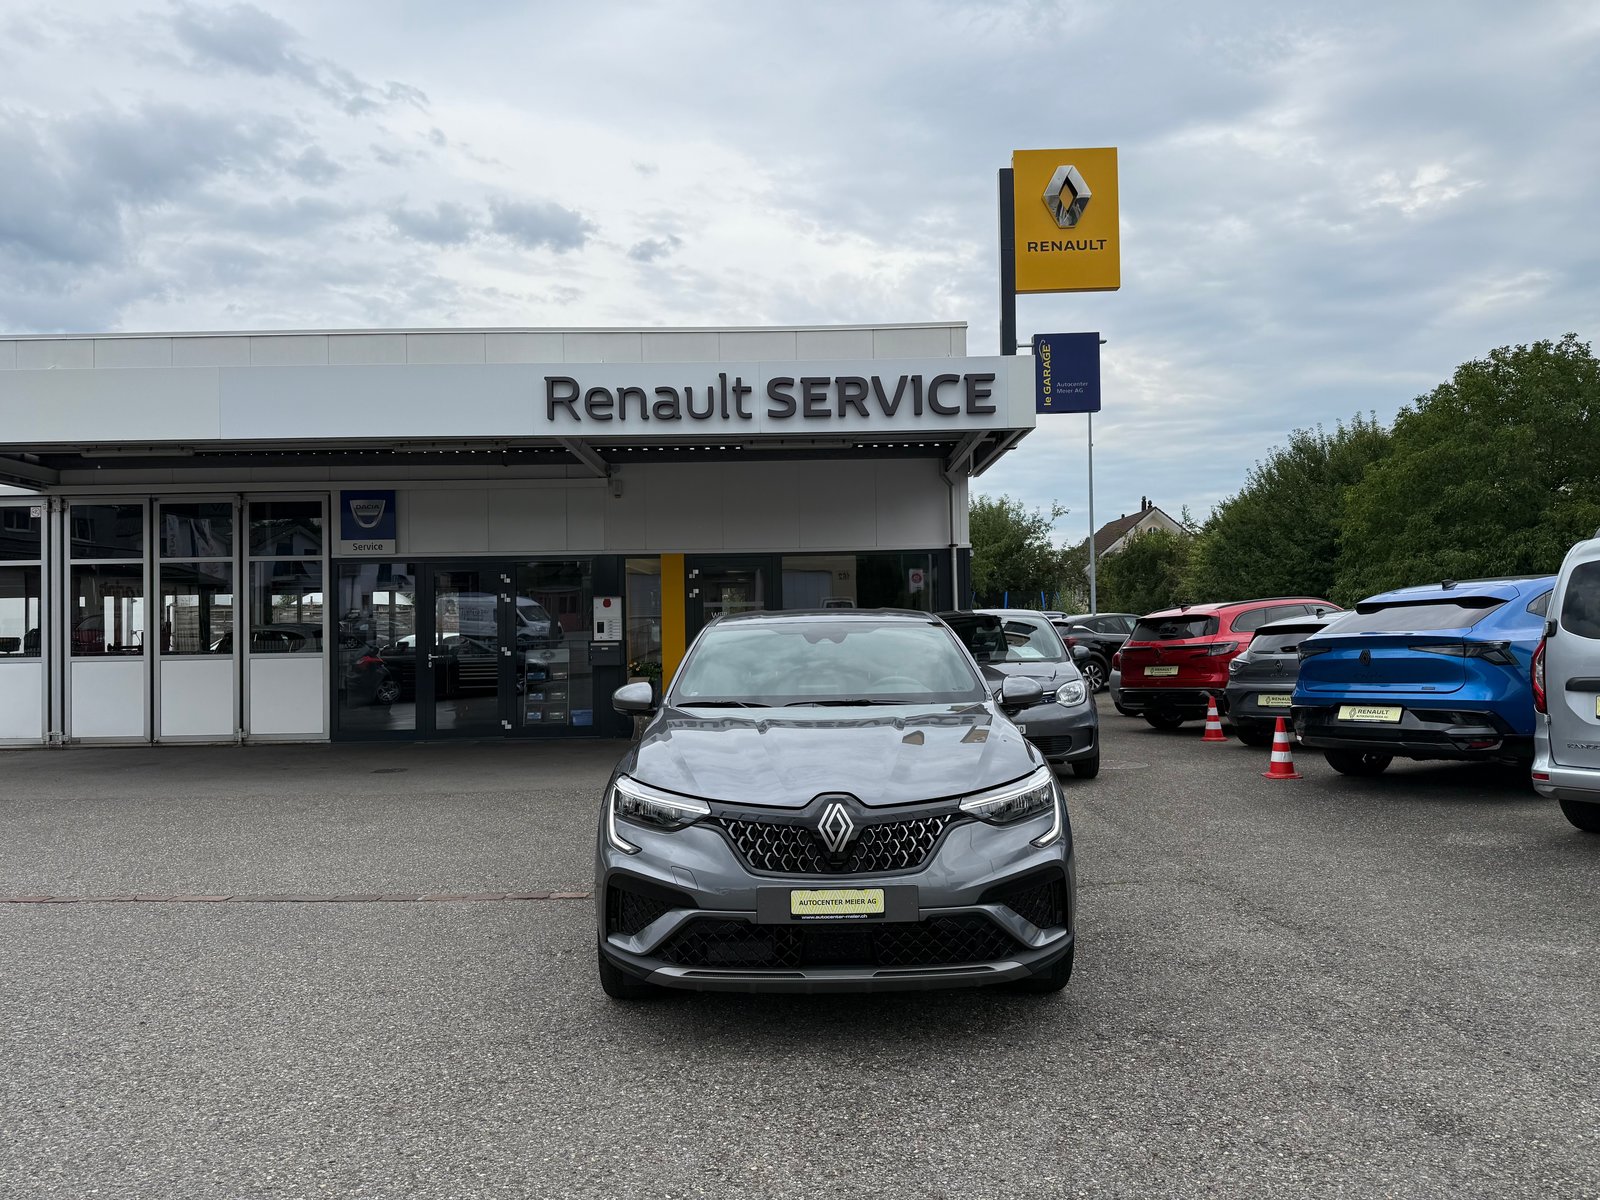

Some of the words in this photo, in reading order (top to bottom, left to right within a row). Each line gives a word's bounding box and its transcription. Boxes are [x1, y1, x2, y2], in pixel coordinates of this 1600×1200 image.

[1027, 239, 1107, 252] RENAULT
[1042, 344, 1051, 395] GARAGE
[544, 373, 752, 422] Renault
[766, 373, 997, 419] SERVICE
[1044, 396, 1052, 406] le
[352, 542, 383, 551] Service
